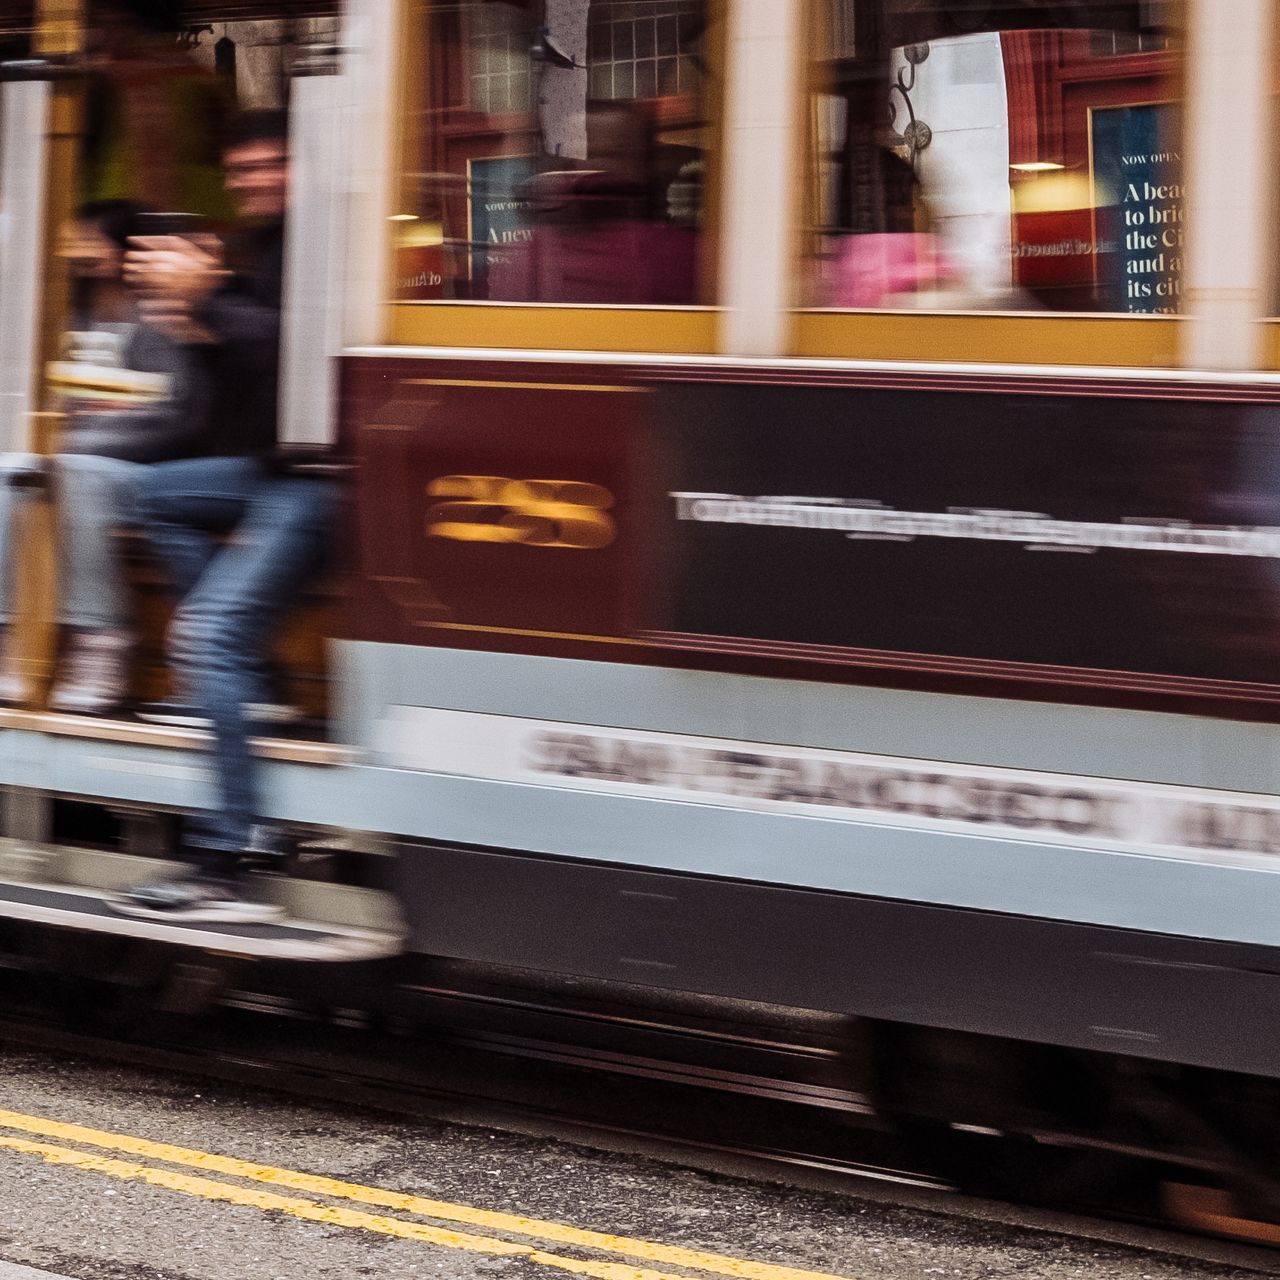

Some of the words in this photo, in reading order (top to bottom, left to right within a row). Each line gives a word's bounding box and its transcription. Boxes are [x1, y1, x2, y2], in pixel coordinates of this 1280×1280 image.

[1121, 154, 1147, 165] NOW
[1124, 183, 1140, 202] A
[1124, 207, 1144, 226] to
[502, 228, 535, 245] new
[1125, 230, 1157, 251] the
[1126, 253, 1165, 274] and
[1127, 279, 1152, 298] its
